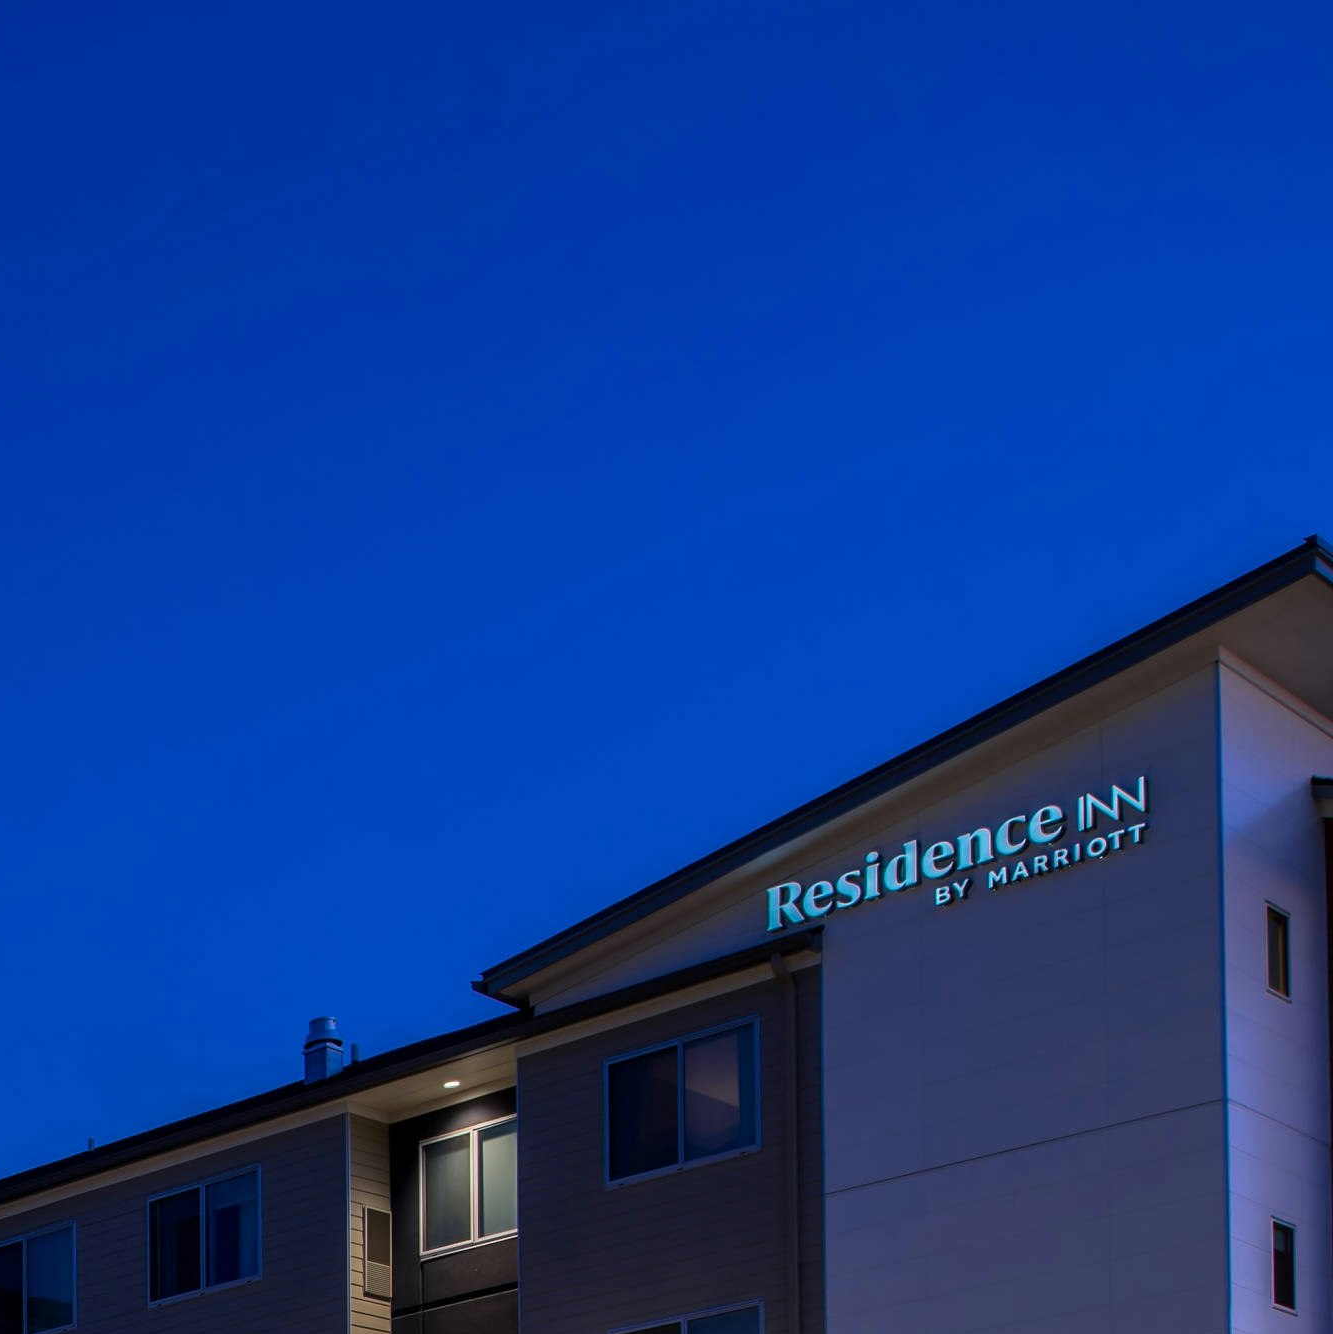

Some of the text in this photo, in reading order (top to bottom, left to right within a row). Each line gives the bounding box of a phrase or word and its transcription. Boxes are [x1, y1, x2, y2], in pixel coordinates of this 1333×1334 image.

[765, 775, 1148, 932] Residence INN
[934, 822, 1147, 906] BY MARRIOTT
